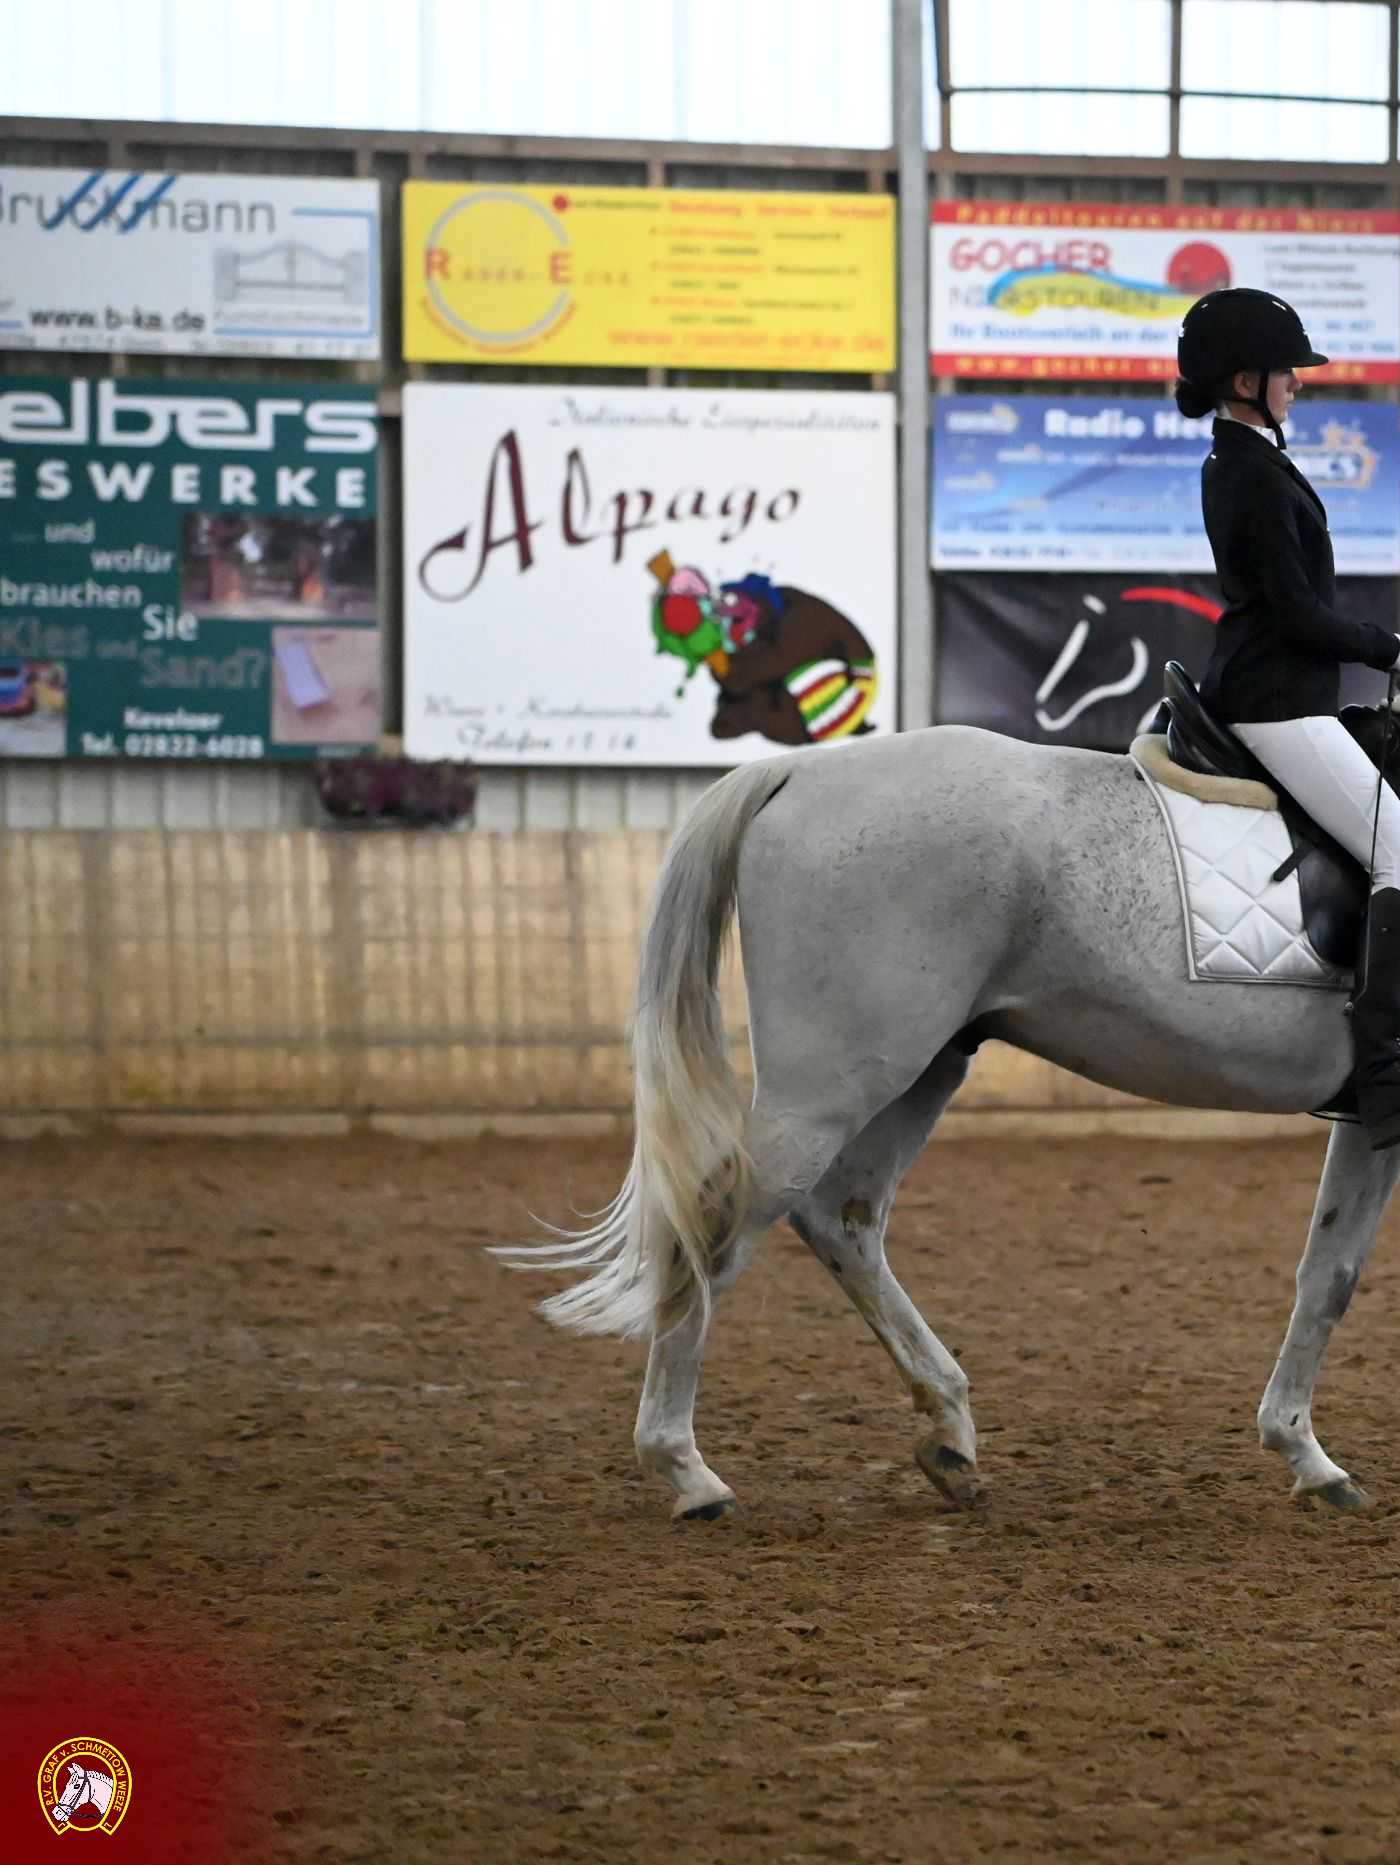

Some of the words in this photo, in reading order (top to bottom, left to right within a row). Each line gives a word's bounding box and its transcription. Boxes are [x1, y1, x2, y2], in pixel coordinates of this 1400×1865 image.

[0, 184, 276, 234] ruckmann
[949, 238, 1113, 273] GOCHER
[0, 378, 378, 453] elbers
[1045, 408, 1145, 438] Radio
[419, 429, 802, 603] Alpago
[1, 577, 142, 608] brauchen
[142, 603, 199, 641] Sie
